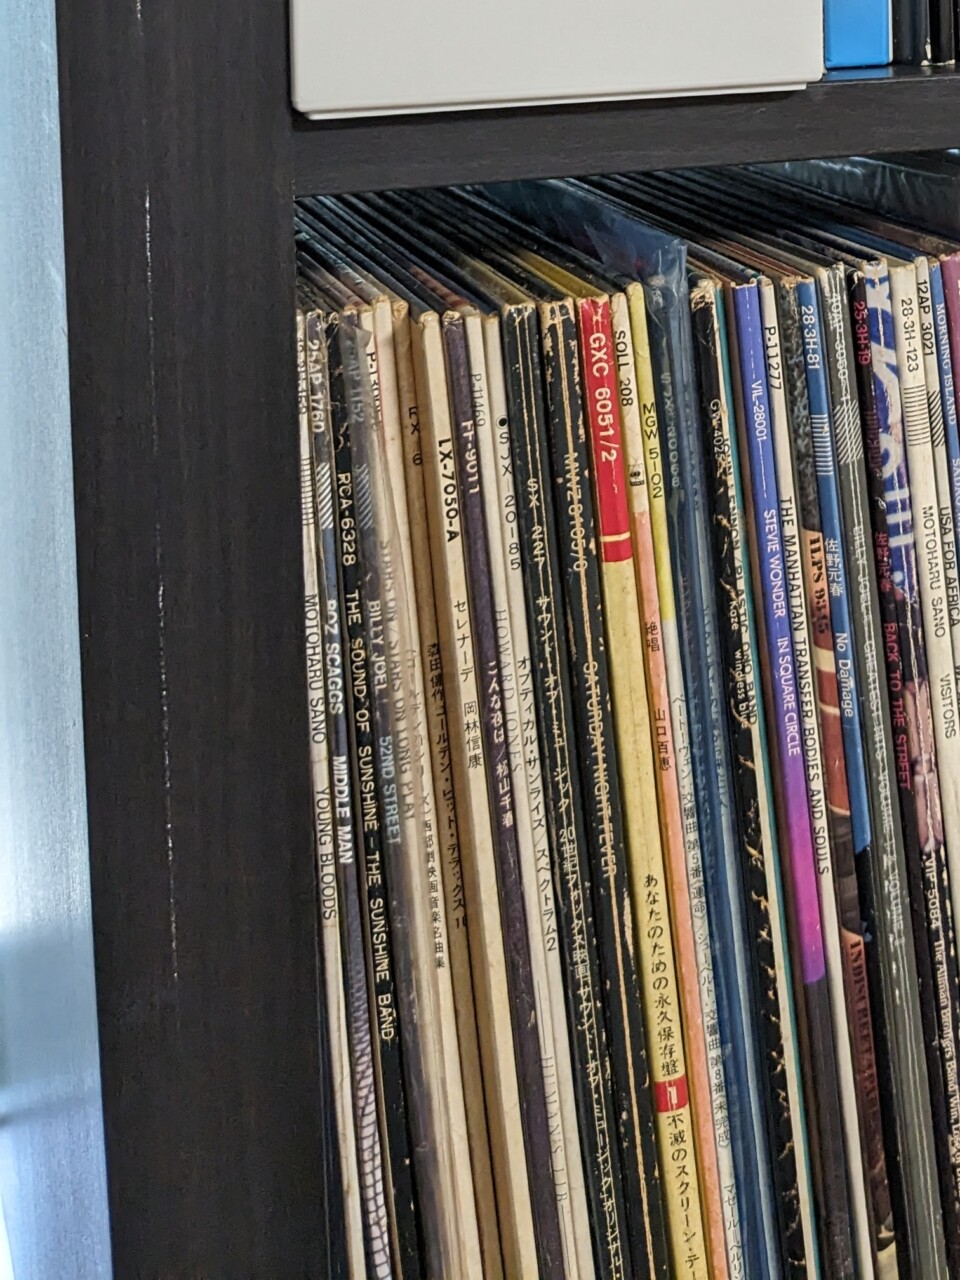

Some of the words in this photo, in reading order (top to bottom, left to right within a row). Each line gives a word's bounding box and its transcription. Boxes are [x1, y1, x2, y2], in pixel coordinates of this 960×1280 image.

[917, 279, 931, 315] 12AP
[588, 332, 610, 378] GXC
[614, 329, 631, 372] SOLL
[764, 325, 782, 390] P-11277
[920, 322, 935, 357] 3021
[935, 303, 952, 370] MORNING
[619, 380, 634, 407] 208
[750, 380, 767, 442] VIL-28001
[942, 372, 958, 425] ISLAND
[593, 387, 618, 462] 6051/2
[438, 438, 460, 542] LX-7050-A
[780, 496, 795, 528] THE
[338, 472, 356, 566] RCA-6328
[763, 509, 780, 556] STEVIE
[939, 506, 952, 536] USA
[808, 536, 828, 584] ILPS
[823, 537, 844, 597] 佐野元春
[921, 506, 940, 591] MOTOHARU
[942, 541, 957, 570] FOR
[345, 590, 361, 625] THE
[768, 557, 787, 618] WONDER
[783, 534, 806, 632] MANHATTAN
[945, 576, 960, 627] AFRICA
[303, 594, 323, 691] MOTOHARU
[368, 599, 384, 645] BILLY
[453, 600, 473, 683] セレナーデ
[834, 632, 848, 652] No
[882, 622, 899, 662] BACK
[930, 597, 946, 638] SANO
[350, 638, 368, 697] SOUND
[776, 637, 790, 653] IN
[327, 642, 344, 714] SCAGGS
[372, 652, 388, 692] JOEL
[778, 656, 796, 712] SQUARE
[836, 659, 856, 718] Damage
[889, 670, 902, 690] TO
[310, 698, 327, 744] SANO
[355, 709, 370, 732] OF
[583, 660, 608, 764] SATURDAY
[891, 698, 906, 728] THE
[939, 673, 957, 739] VISITORS
[655, 708, 671, 771] 山口百恵
[784, 712, 800, 757] CIRCLE
[332, 756, 350, 817] MIDDLE
[893, 733, 912, 790] STREET
[359, 745, 380, 831] SUNSHINE
[591, 769, 612, 819] NIGHT
[808, 788, 823, 820] AND
[315, 786, 333, 846] YOUNG
[338, 825, 353, 864] MAN
[366, 851, 381, 884] THE
[598, 822, 617, 880] FEVER
[812, 827, 830, 875] SOULS
[319, 852, 337, 920] BLOODS
[369, 896, 390, 984] SUNSHINE
[377, 991, 394, 1041] BAND
